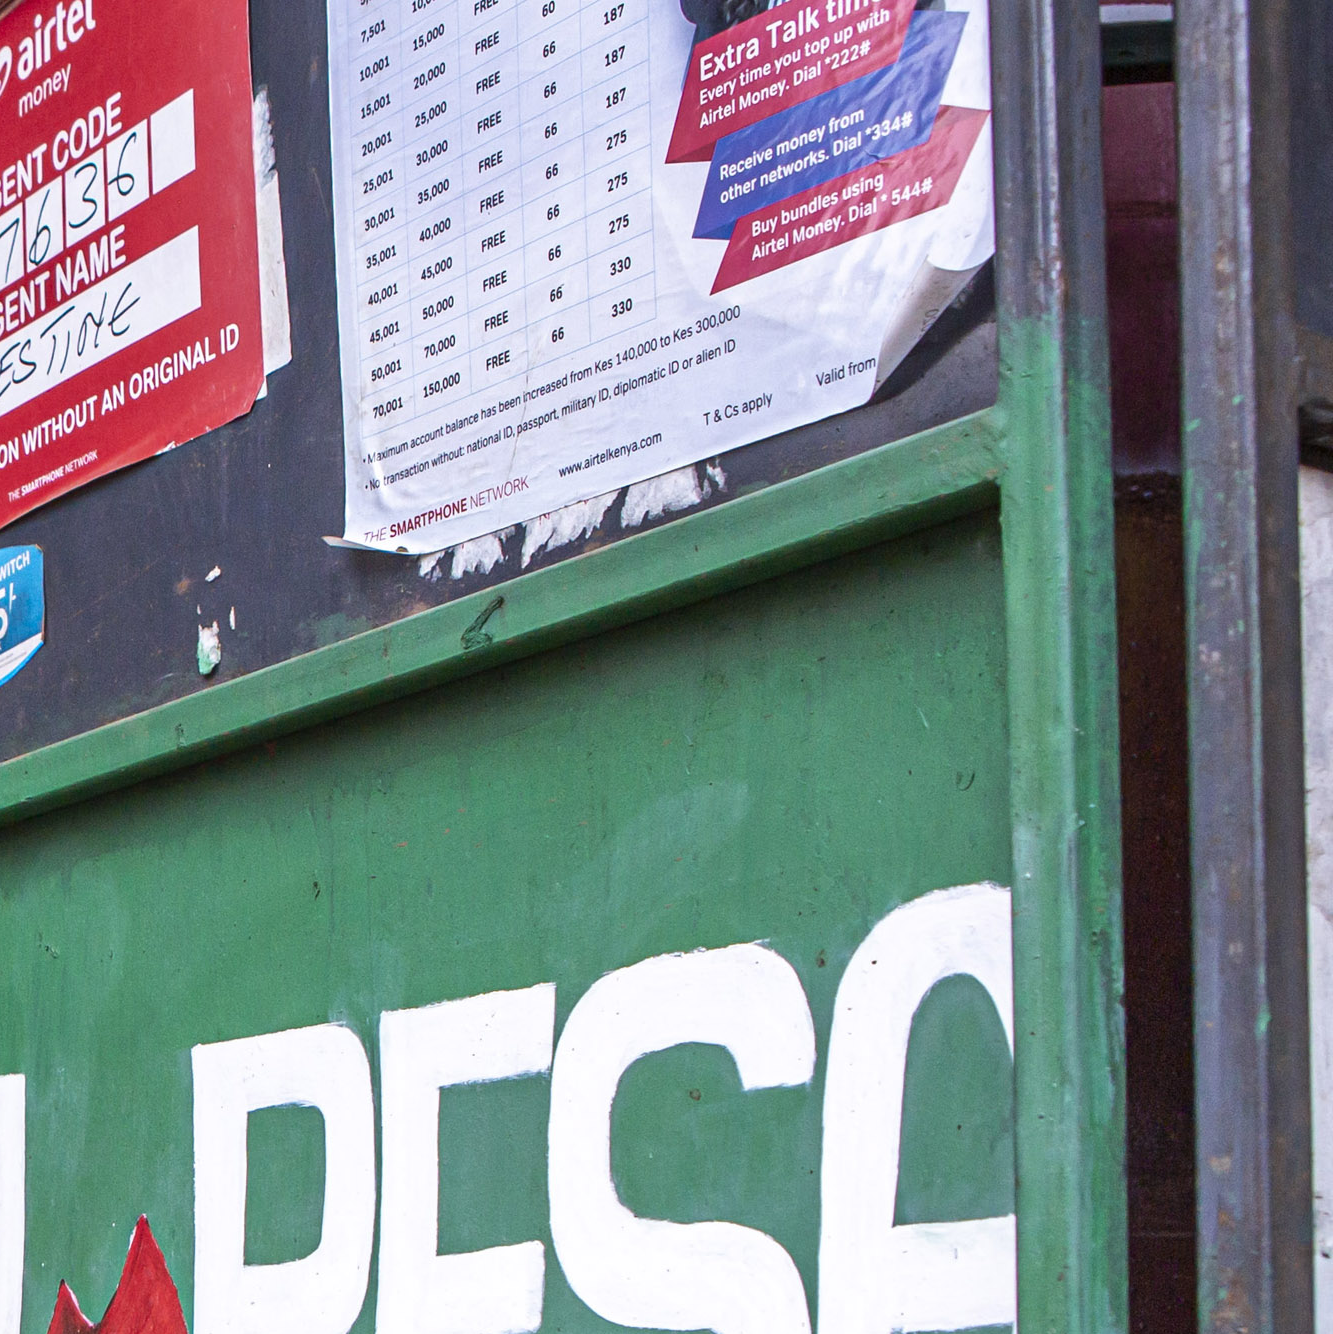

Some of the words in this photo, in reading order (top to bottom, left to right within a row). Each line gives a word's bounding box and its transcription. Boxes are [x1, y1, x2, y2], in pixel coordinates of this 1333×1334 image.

[17, 0, 96, 80] airtel
[359, 55, 390, 83] 10,001
[412, 23, 446, 52] 15,000
[473, 0, 500, 17] FREE
[360, 19, 386, 43] 7,501
[360, 92, 392, 120] 15,001
[412, 61, 446, 91] 20,000
[474, 30, 500, 56] FREE
[541, 0, 556, 18] 60
[699, 37, 760, 82] Extra
[764, 5, 820, 49] Talk
[824, 0, 882, 23] tim
[699, 78, 737, 108] Every
[738, 62, 772, 87] time
[773, 48, 802, 75] you
[803, 35, 831, 57] top
[833, 25, 854, 45] up
[856, 8, 890, 35] with
[18, 63, 71, 117] money
[361, 130, 393, 157] 20,001
[414, 100, 448, 129] 25,000
[475, 70, 501, 95] FREE
[542, 40, 556, 59] 66
[603, 2, 625, 26] 187
[362, 168, 394, 195] 25,001
[415, 139, 449, 167] 30,000
[476, 109, 502, 135] FREE
[543, 81, 557, 99] 66
[604, 44, 626, 68] 187
[698, 98, 736, 129] Airtel
[738, 79, 790, 111] Money.
[792, 59, 822, 87] Dial
[52, 92, 122, 169] CODE
[364, 206, 396, 233] 30,001
[417, 177, 450, 205] 35,000
[478, 149, 504, 175] FREE
[544, 121, 558, 140] 66
[605, 86, 627, 109] 187
[719, 147, 774, 181] Receive
[776, 124, 826, 157] money
[828, 109, 865, 135] from
[719, 177, 758, 204] other
[759, 149, 830, 188] networks.
[832, 131, 862, 157] Dial
[365, 244, 398, 270] 35,001
[418, 217, 452, 243] 40,000
[479, 189, 505, 214] FREE
[545, 162, 559, 181] 66
[605, 129, 628, 151] 275
[367, 282, 399, 306] 40,001
[420, 256, 453, 281] 45,000
[480, 229, 507, 253] FREE
[546, 203, 560, 221] 66
[606, 171, 628, 193] 275
[751, 215, 779, 238] Buy
[780, 191, 839, 226] bundles
[841, 173, 884, 201] using
[751, 231, 790, 262] Airtel
[792, 214, 846, 245] Money.
[848, 197, 878, 223] Dial
[891, 176, 934, 206] 544#
[56, 224, 126, 299] NAME
[369, 320, 401, 344] 45,001
[422, 295, 455, 321] 50,000
[482, 269, 508, 293] FREE
[547, 244, 562, 262] 66
[608, 213, 630, 235] 275
[370, 358, 402, 383] 50,001
[423, 333, 456, 359] 70,000
[484, 309, 510, 333] FREE
[549, 285, 564, 303] 66
[609, 255, 632, 277] 330
[372, 396, 404, 420] 70,001
[422, 371, 461, 399] 150,000
[485, 349, 511, 372] FREE
[551, 326, 565, 343] 66
[610, 297, 633, 319] 330
[21, 394, 99, 455] WITHOUT
[100, 381, 126, 416] AN
[128, 336, 217, 400] ORIGINAL
[220, 324, 240, 354] ID
[367, 441, 410, 465] Maximum
[409, 425, 445, 450] account
[444, 412, 480, 435] balance
[480, 405, 498, 421] has
[498, 395, 522, 414] been
[522, 373, 569, 403] increased
[569, 366, 594, 385] from
[594, 357, 614, 375] Kes
[615, 337, 658, 367] 140,000
[659, 335, 672, 349] to
[672, 326, 694, 344] Kes
[694, 304, 742, 335] 300,000
[702, 411, 712, 427] T
[713, 408, 723, 423] &
[724, 403, 740, 419] Cs
[741, 392, 773, 415] apply
[815, 364, 846, 387] Valid
[847, 357, 876, 377] from
[368, 477, 381, 492] No
[383, 460, 430, 487] transaction
[430, 445, 466, 469] without:
[464, 429, 502, 455] national
[502, 425, 516, 441] ID,
[516, 407, 560, 439] passport,
[560, 395, 596, 418] military
[593, 387, 612, 406] ID,
[612, 366, 667, 397] diplomatic
[668, 359, 680, 376] ID
[681, 357, 694, 371] or
[695, 346, 722, 366] alien
[723, 338, 737, 355] ID
[558, 432, 663, 479] www.airtelkenya.com
[7, 488, 21, 503] THE
[20, 464, 65, 497] SMARTPHONE
[64, 449, 99, 476] NETWORK
[363, 526, 388, 543] THE
[389, 497, 468, 538] SMARTPHONE
[469, 475, 530, 510] NETWORK
